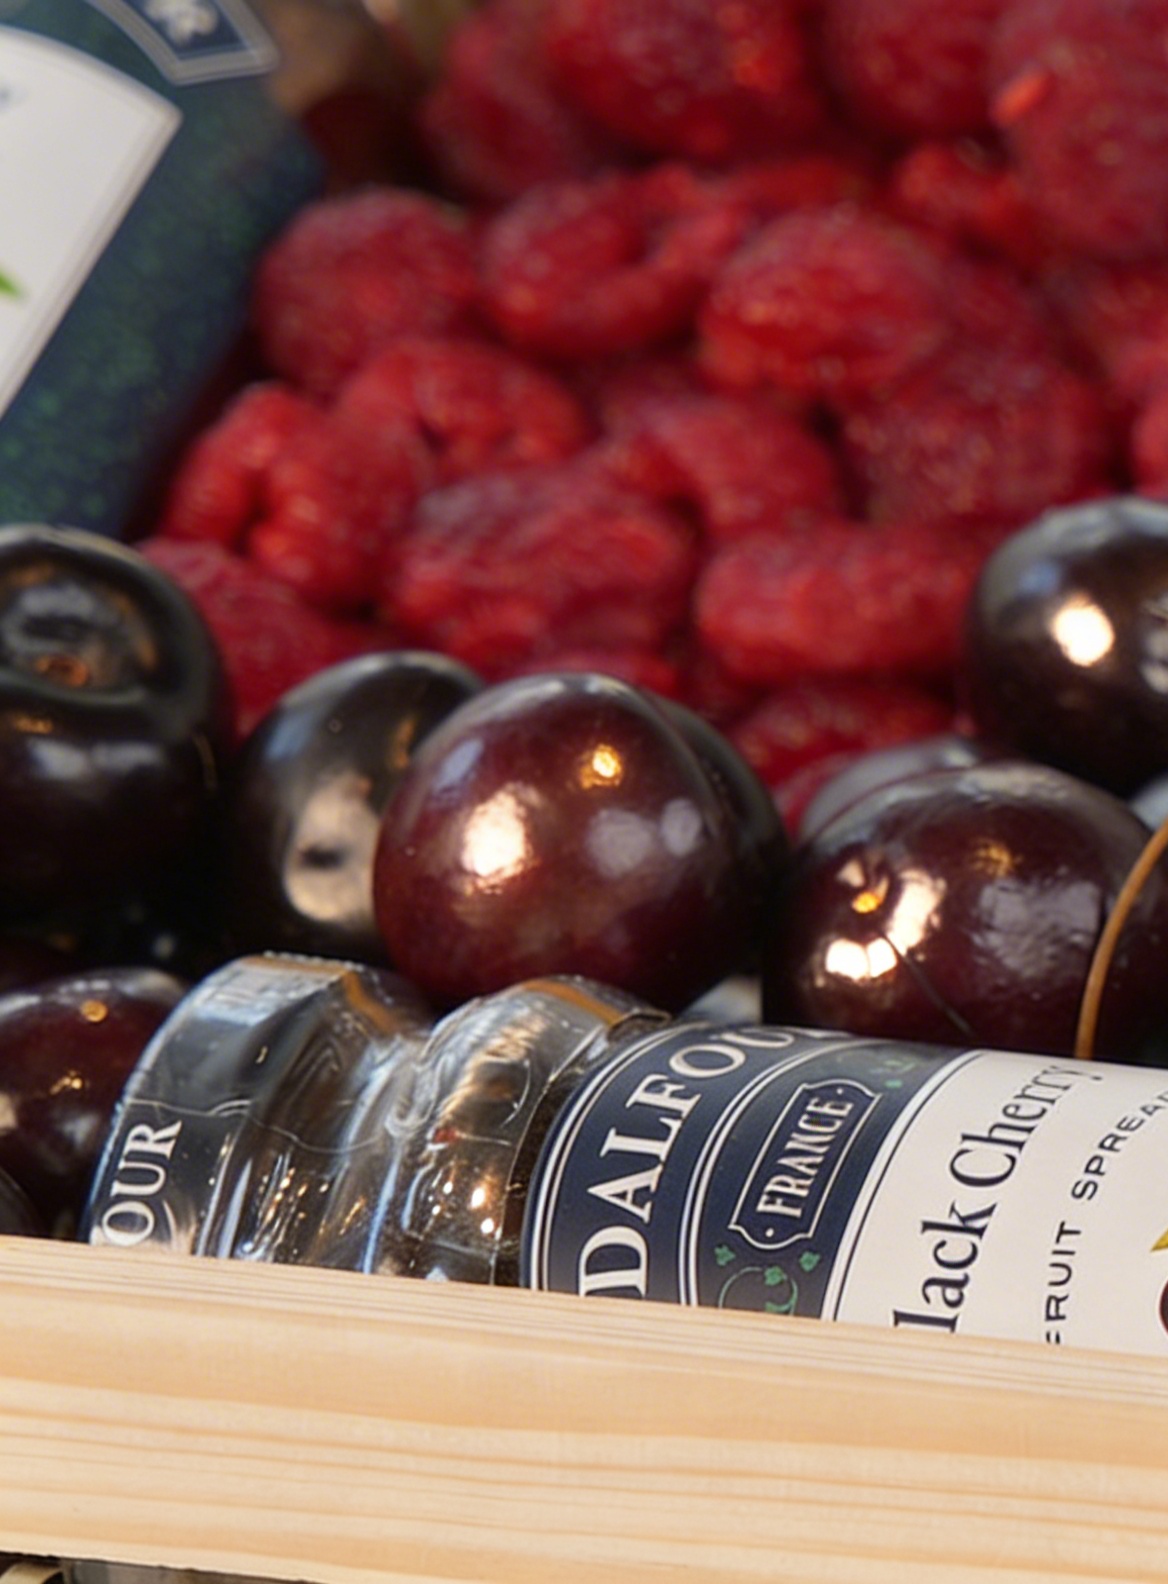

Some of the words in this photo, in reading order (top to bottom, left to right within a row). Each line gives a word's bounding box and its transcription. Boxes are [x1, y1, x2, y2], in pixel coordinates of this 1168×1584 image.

[91, 1120, 182, 1246] OUR
[578, 1027, 853, 1299] DALFOU
[755, 1096, 854, 1219] FRANCE
[892, 1200, 998, 1334] lack
[949, 1064, 1104, 1188] Cherry
